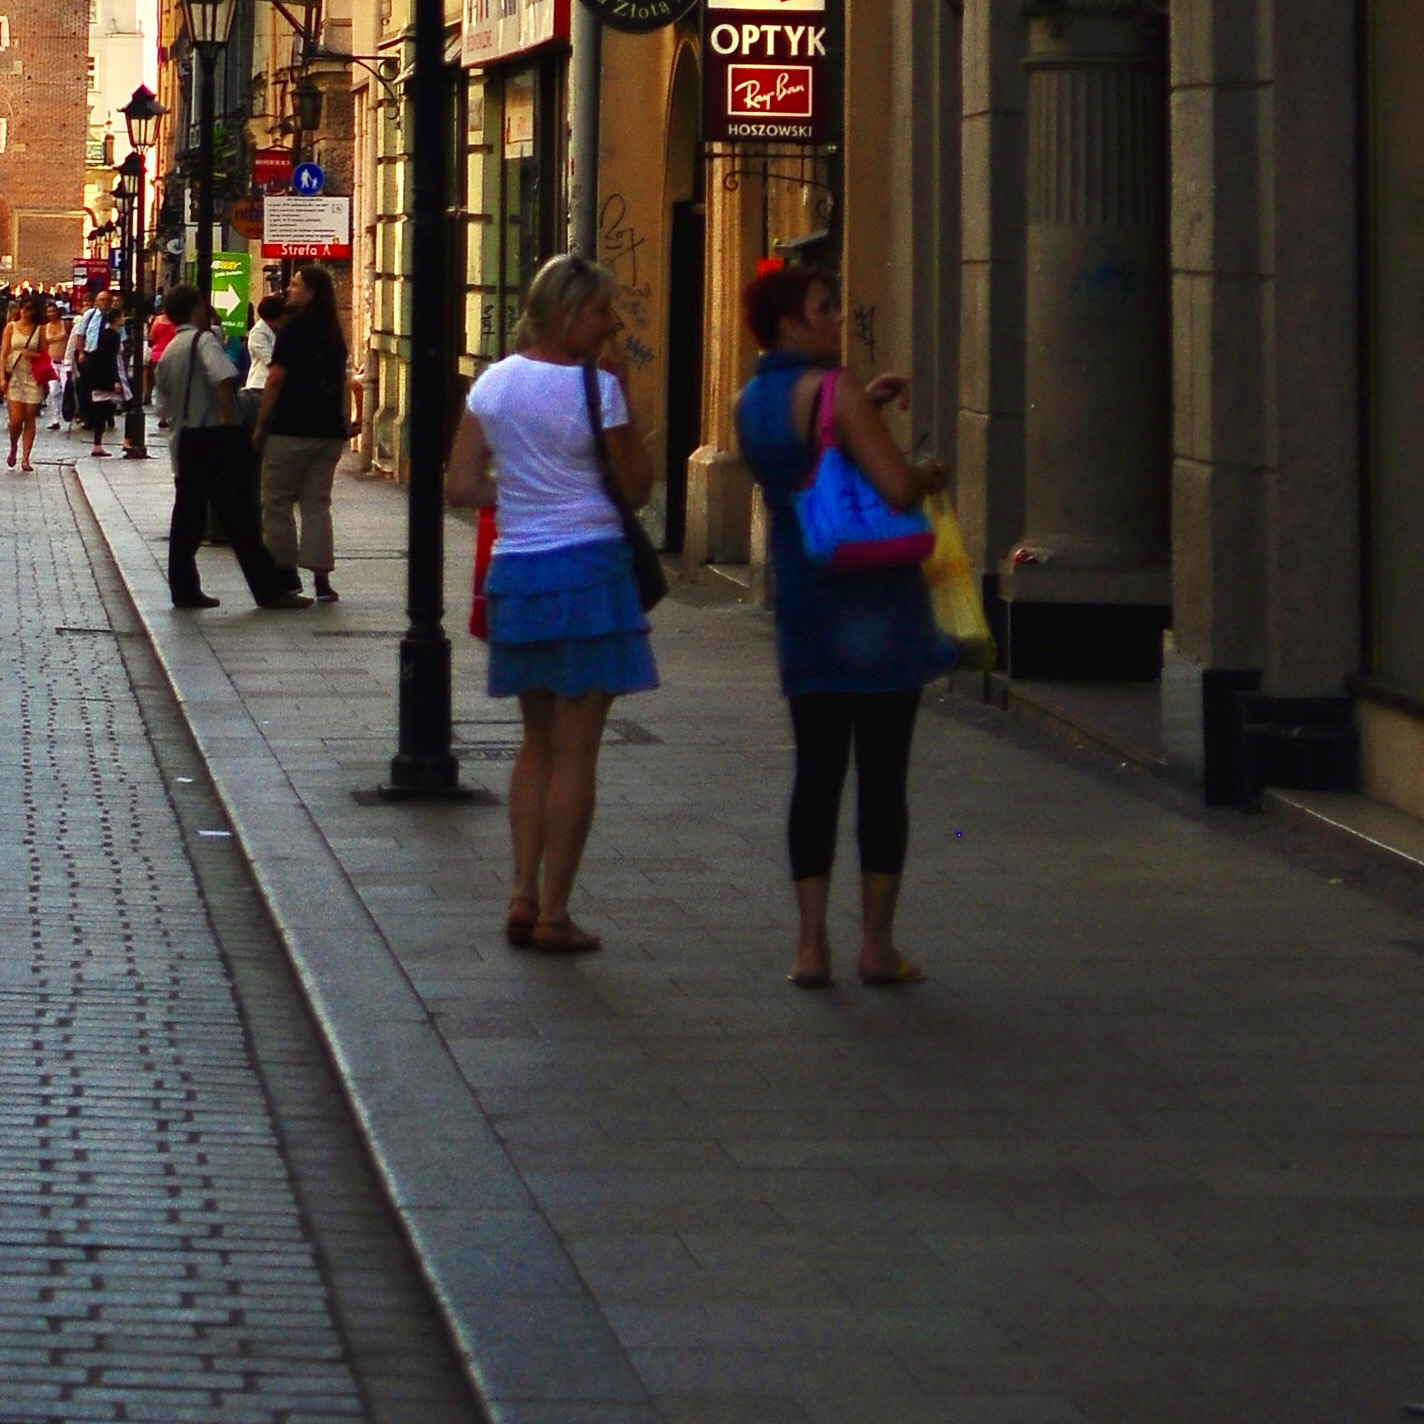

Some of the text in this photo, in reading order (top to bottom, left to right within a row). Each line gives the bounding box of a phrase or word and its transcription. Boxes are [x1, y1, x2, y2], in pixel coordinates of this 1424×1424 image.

[710, 23, 826, 57] OPTYK
[734, 72, 806, 111] Ray-Ban
[728, 123, 813, 138] HOSZOWSKI
[280, 243, 318, 256] Strefa
